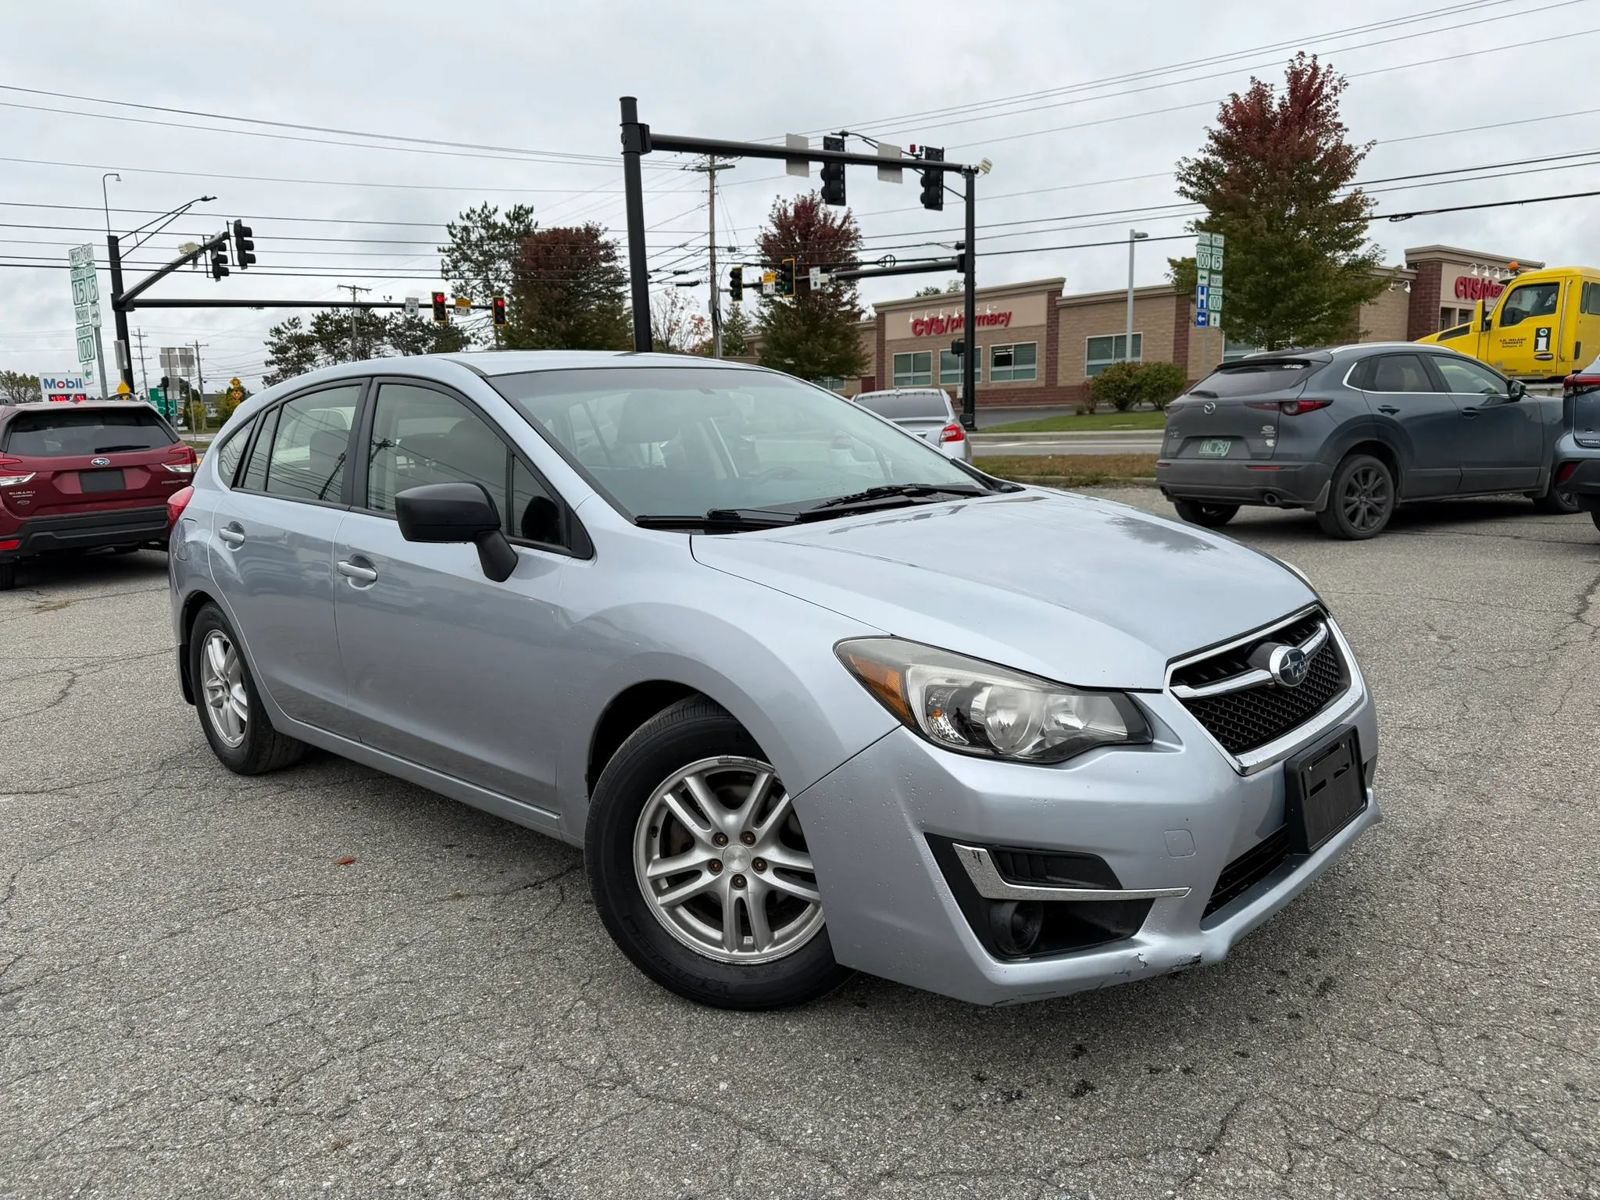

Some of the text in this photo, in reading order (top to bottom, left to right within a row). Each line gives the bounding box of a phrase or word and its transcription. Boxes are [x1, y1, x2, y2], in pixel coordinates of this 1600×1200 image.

[1198, 254, 1209, 268] 100
[1214, 256, 1221, 269] 15
[74, 282, 85, 303] 15
[87, 278, 97, 301] 15
[1198, 287, 1207, 308] H
[1210, 296, 1221, 309] 100
[79, 338, 92, 359] 100
[43, 378, 83, 389] Mobil
